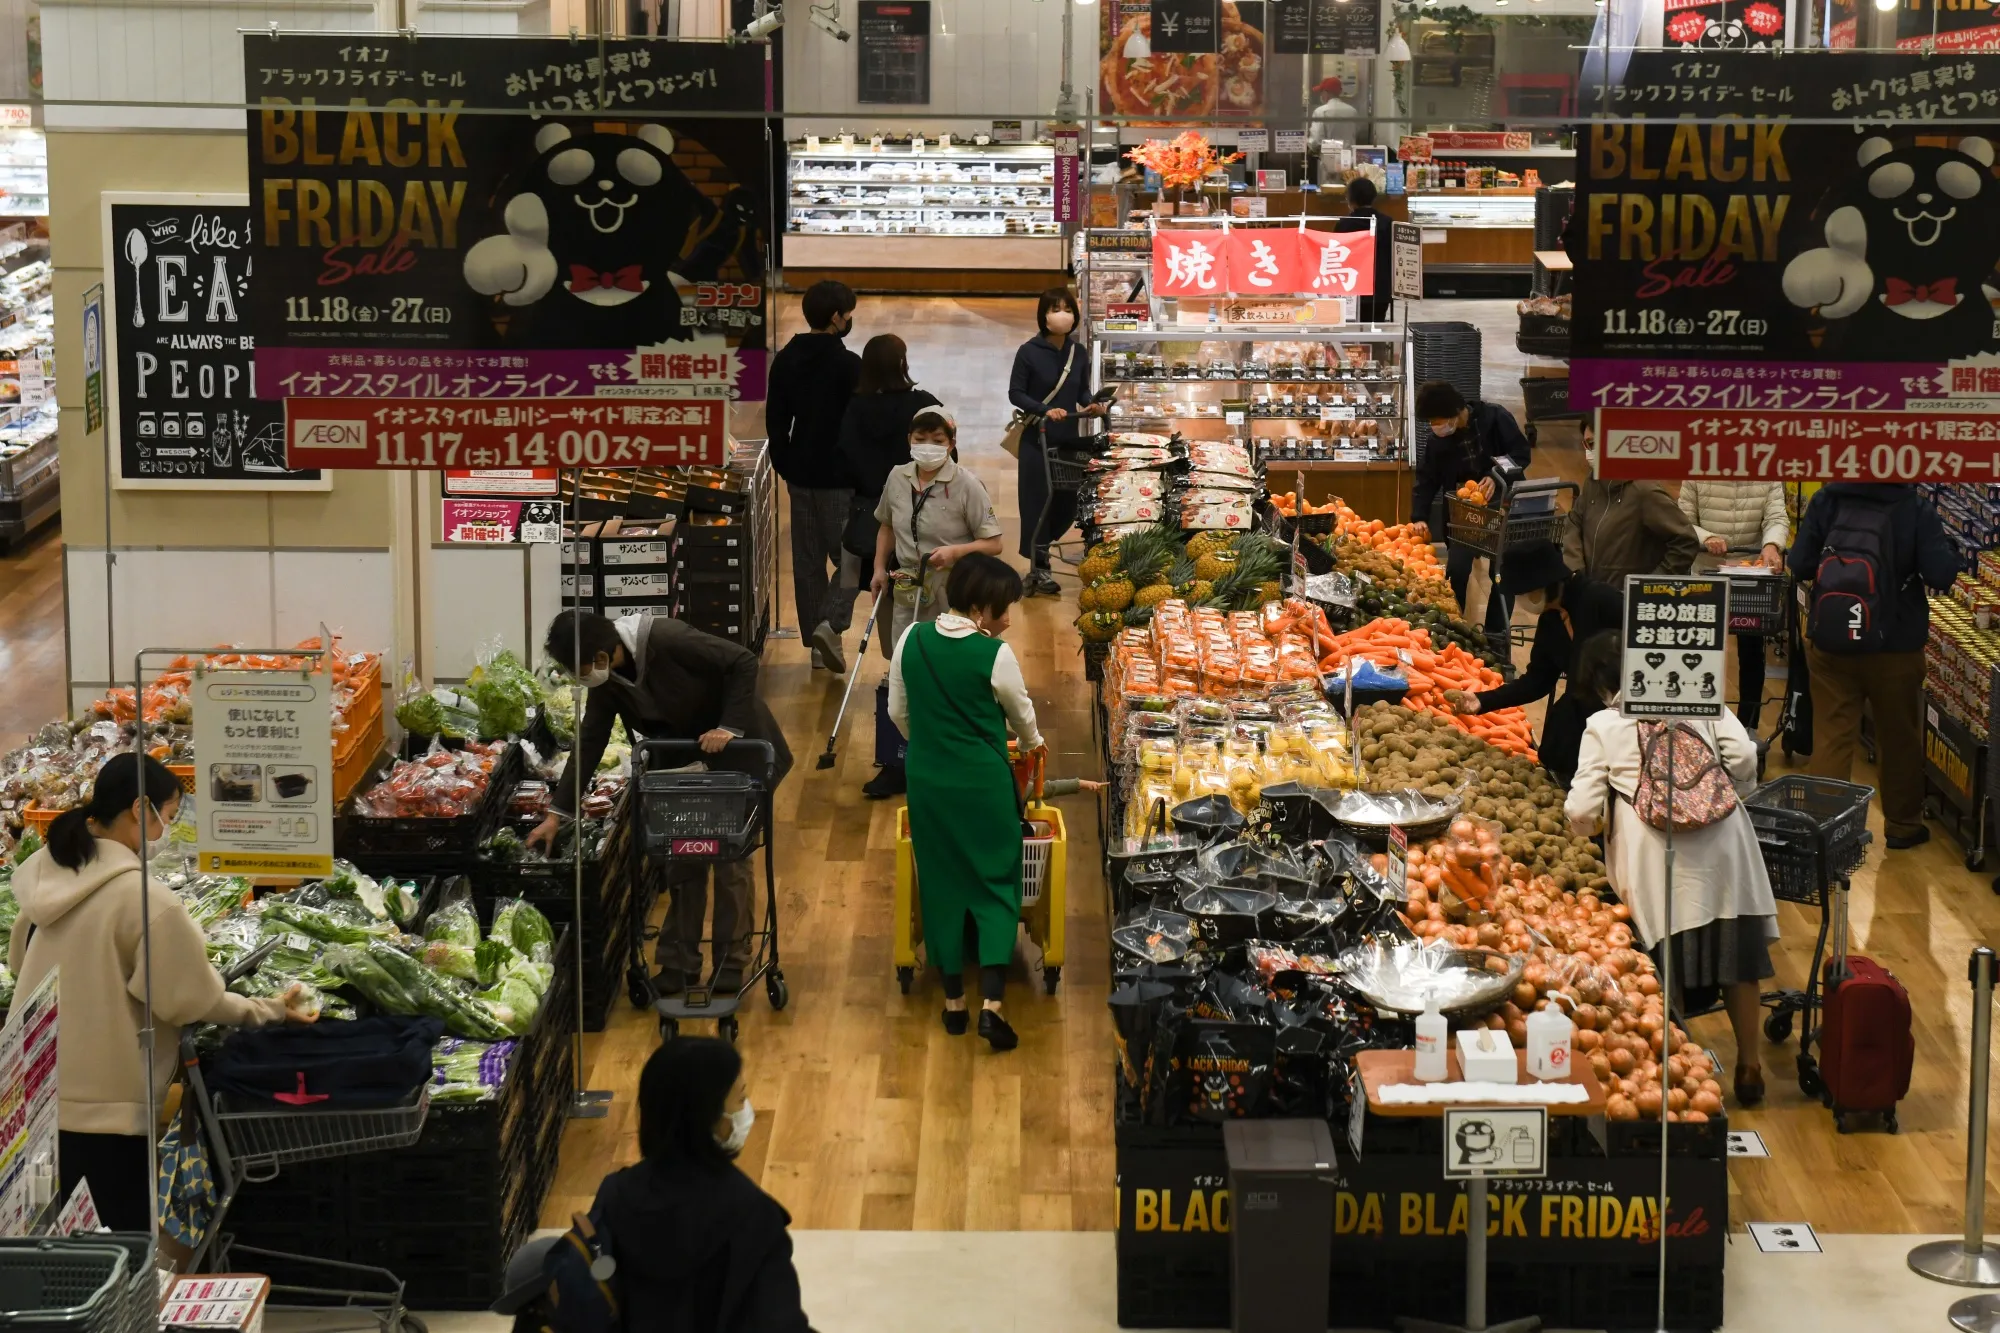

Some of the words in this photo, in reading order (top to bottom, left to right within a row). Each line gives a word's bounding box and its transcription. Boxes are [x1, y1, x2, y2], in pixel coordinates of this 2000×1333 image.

[338, 46, 389, 63] イオン
[260, 69, 414, 86] ブラックフライデー
[421, 70, 466, 87] セール
[505, 48, 652, 97] おトクな真実は
[1671, 62, 1721, 79] イオン
[1592, 85, 1744, 102] ブラックフライデー
[1751, 85, 1794, 102] セール
[1831, 61, 1976, 111] おトクな真実は
[260, 96, 467, 168] BLACK
[1589, 112, 1793, 183] BLACK
[1061, 157, 1071, 221] 安全カメラ作動中
[263, 178, 468, 249] FRIDAY
[152, 225, 177, 237] WHO
[185, 214, 241, 254] like
[1587, 193, 1791, 262] FRIDAY
[1090, 237, 1117, 247] BLACK
[1120, 237, 1147, 247] FRIDAY
[317, 229, 418, 285] Sale
[1635, 242, 1738, 299] Sale
[156, 255, 252, 322] EA
[695, 283, 761, 308] コナン
[171, 335, 223, 350] ALWAYS
[225, 337, 236, 345] THE
[240, 336, 254, 349] BE
[136, 352, 256, 398] PEOP
[588, 362, 620, 380] でも
[641, 353, 728, 379] 開催中!
[1900, 375, 1931, 394] でも
[139, 460, 205, 474] ENJOY!
[452, 508, 511, 519] イオンショップ
[461, 527, 504, 541] 開催中!
[1643, 584, 1668, 594] BLACK
[1688, 583, 1712, 593] FRIDAY
[1636, 602, 1716, 623] 詰め放題
[1848, 602, 1862, 640] FILA
[1635, 626, 1715, 646] お並び列
[228, 708, 296, 722] 使いこなして
[225, 725, 300, 739] もっと便利に!
[1194, 1175, 1223, 1186] イオン
[1494, 1180, 1583, 1190] ブラックフライデー
[1587, 1181, 1613, 1191] セール
[1136, 1188, 1230, 1233] BLAC
[1400, 1192, 1528, 1237] BLACK
[1540, 1194, 1670, 1238] FRIDAY
